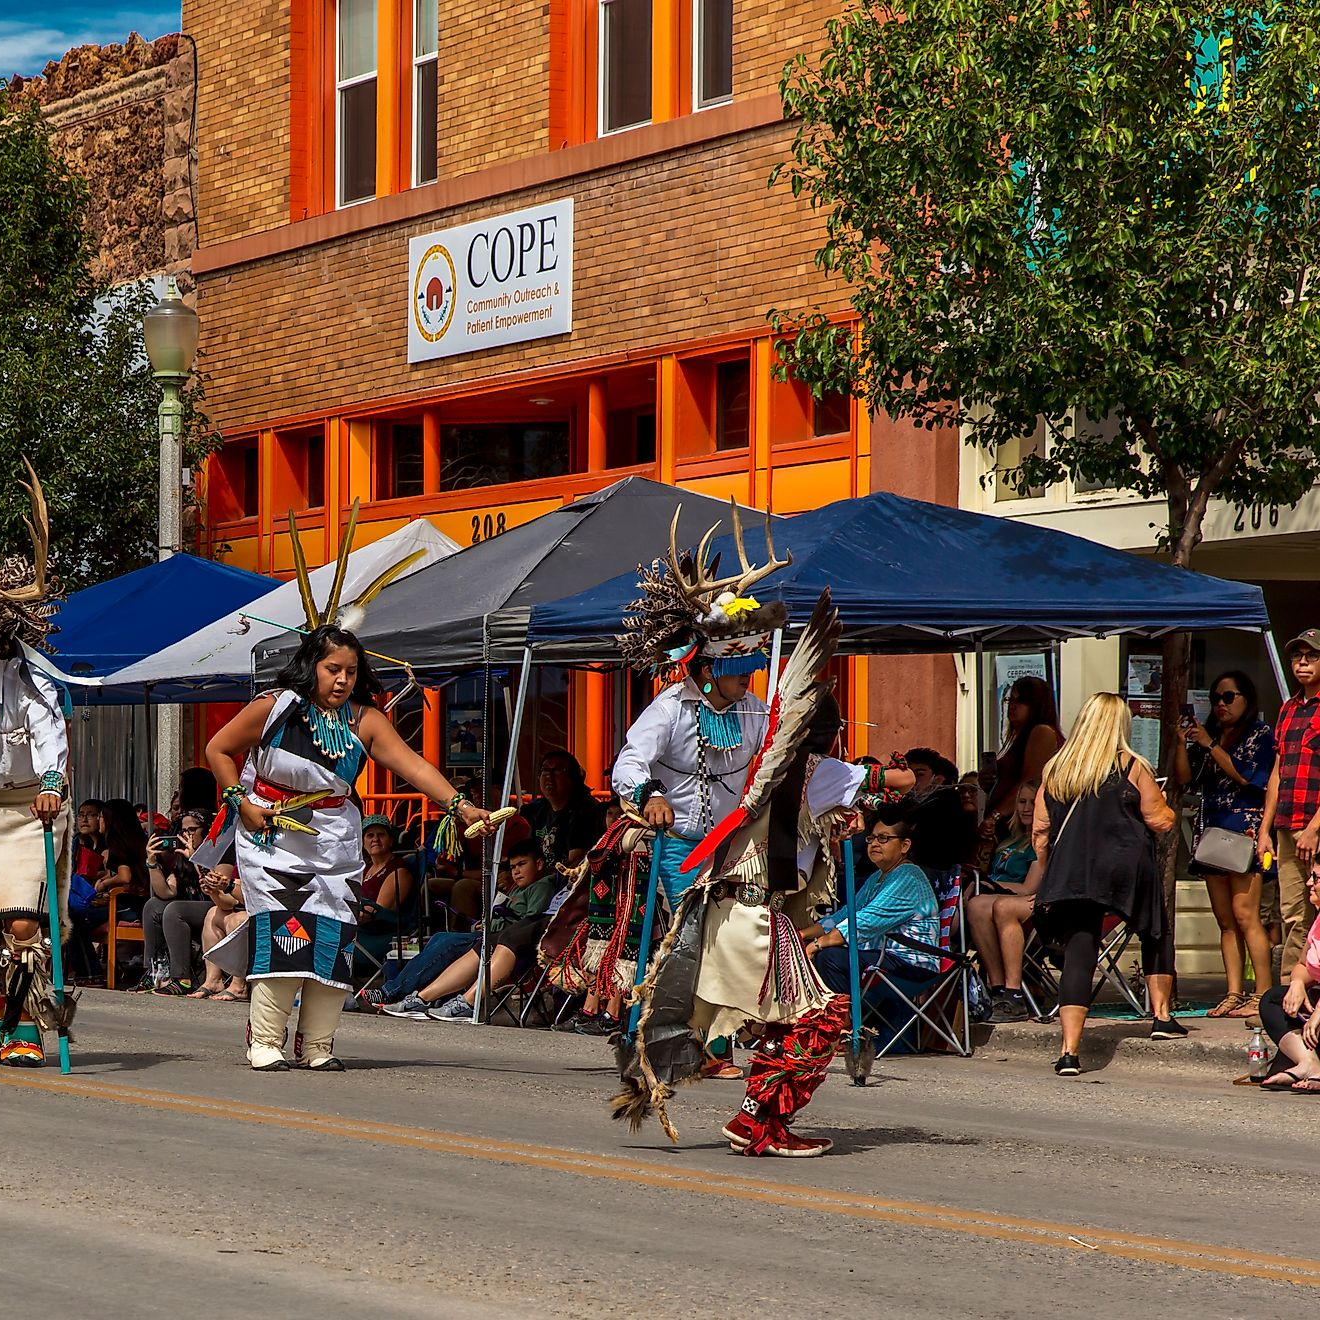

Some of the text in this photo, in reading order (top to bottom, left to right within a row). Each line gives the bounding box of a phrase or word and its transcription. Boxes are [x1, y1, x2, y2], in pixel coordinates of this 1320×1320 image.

[467, 215, 559, 288] COPE
[467, 281, 560, 314] Community Outreach &
[466, 304, 553, 335] Patient Empowerment
[471, 512, 506, 543] 208
[1233, 500, 1279, 531] 206
